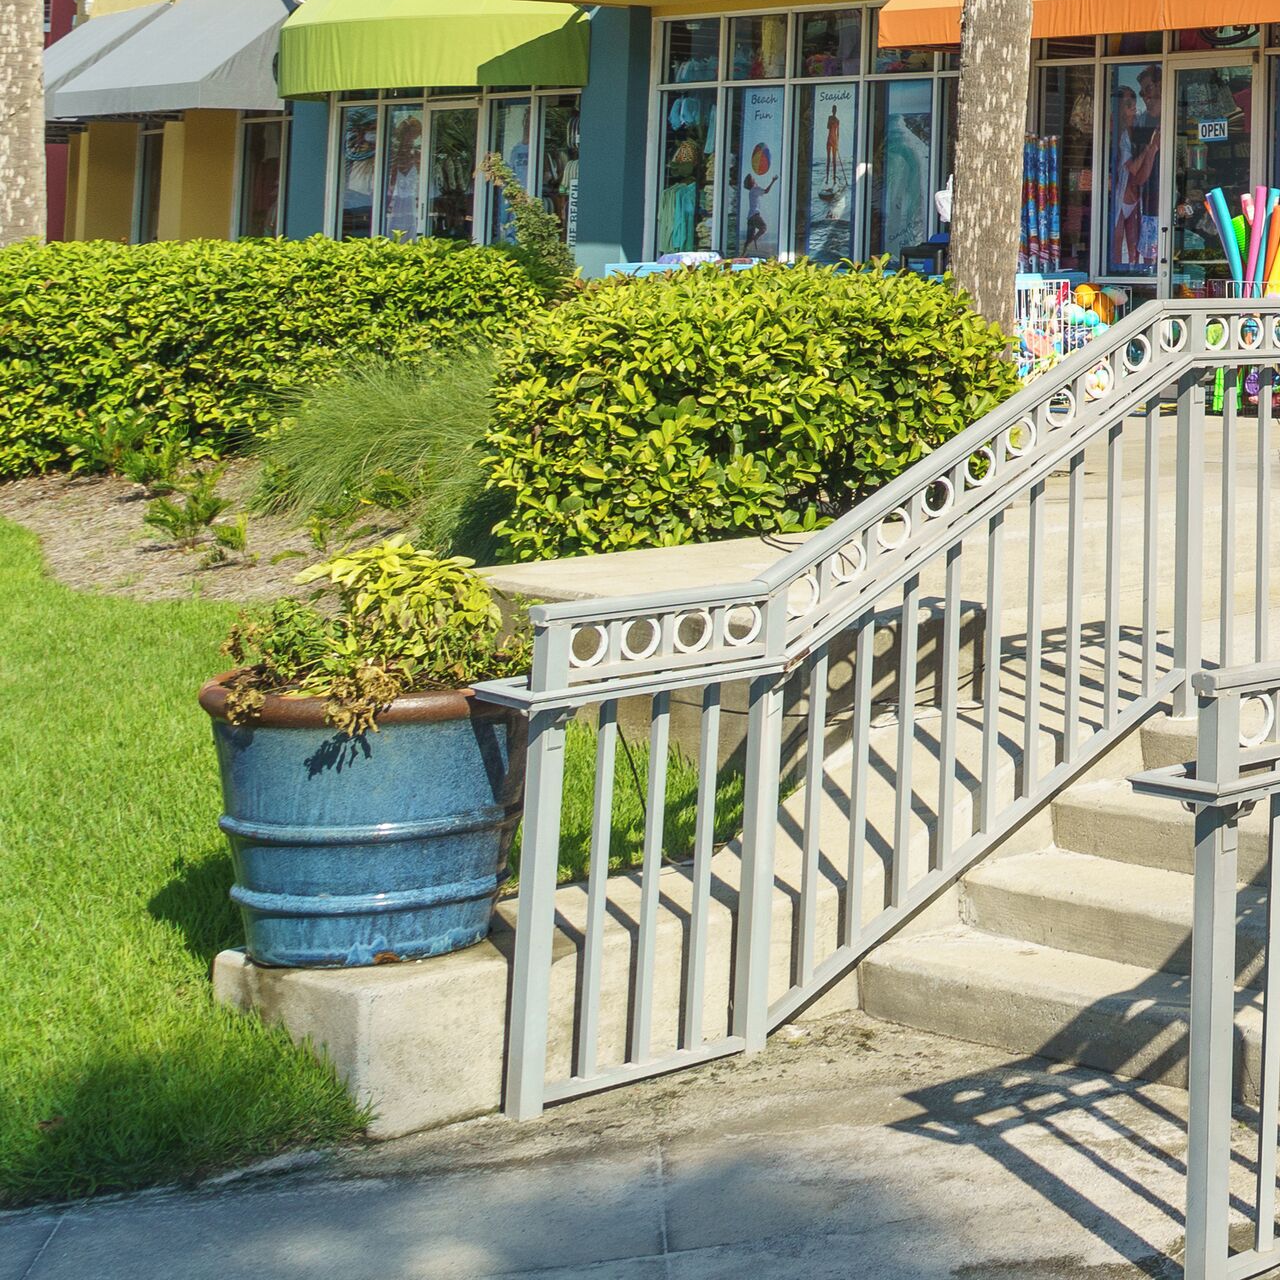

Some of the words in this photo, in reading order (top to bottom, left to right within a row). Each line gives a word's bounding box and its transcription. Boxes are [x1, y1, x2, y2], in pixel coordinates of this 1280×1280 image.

[751, 94, 777, 105] Beach
[819, 90, 853, 102] Seaside
[754, 110, 773, 121] Fun
[1200, 122, 1226, 138] OPEN
